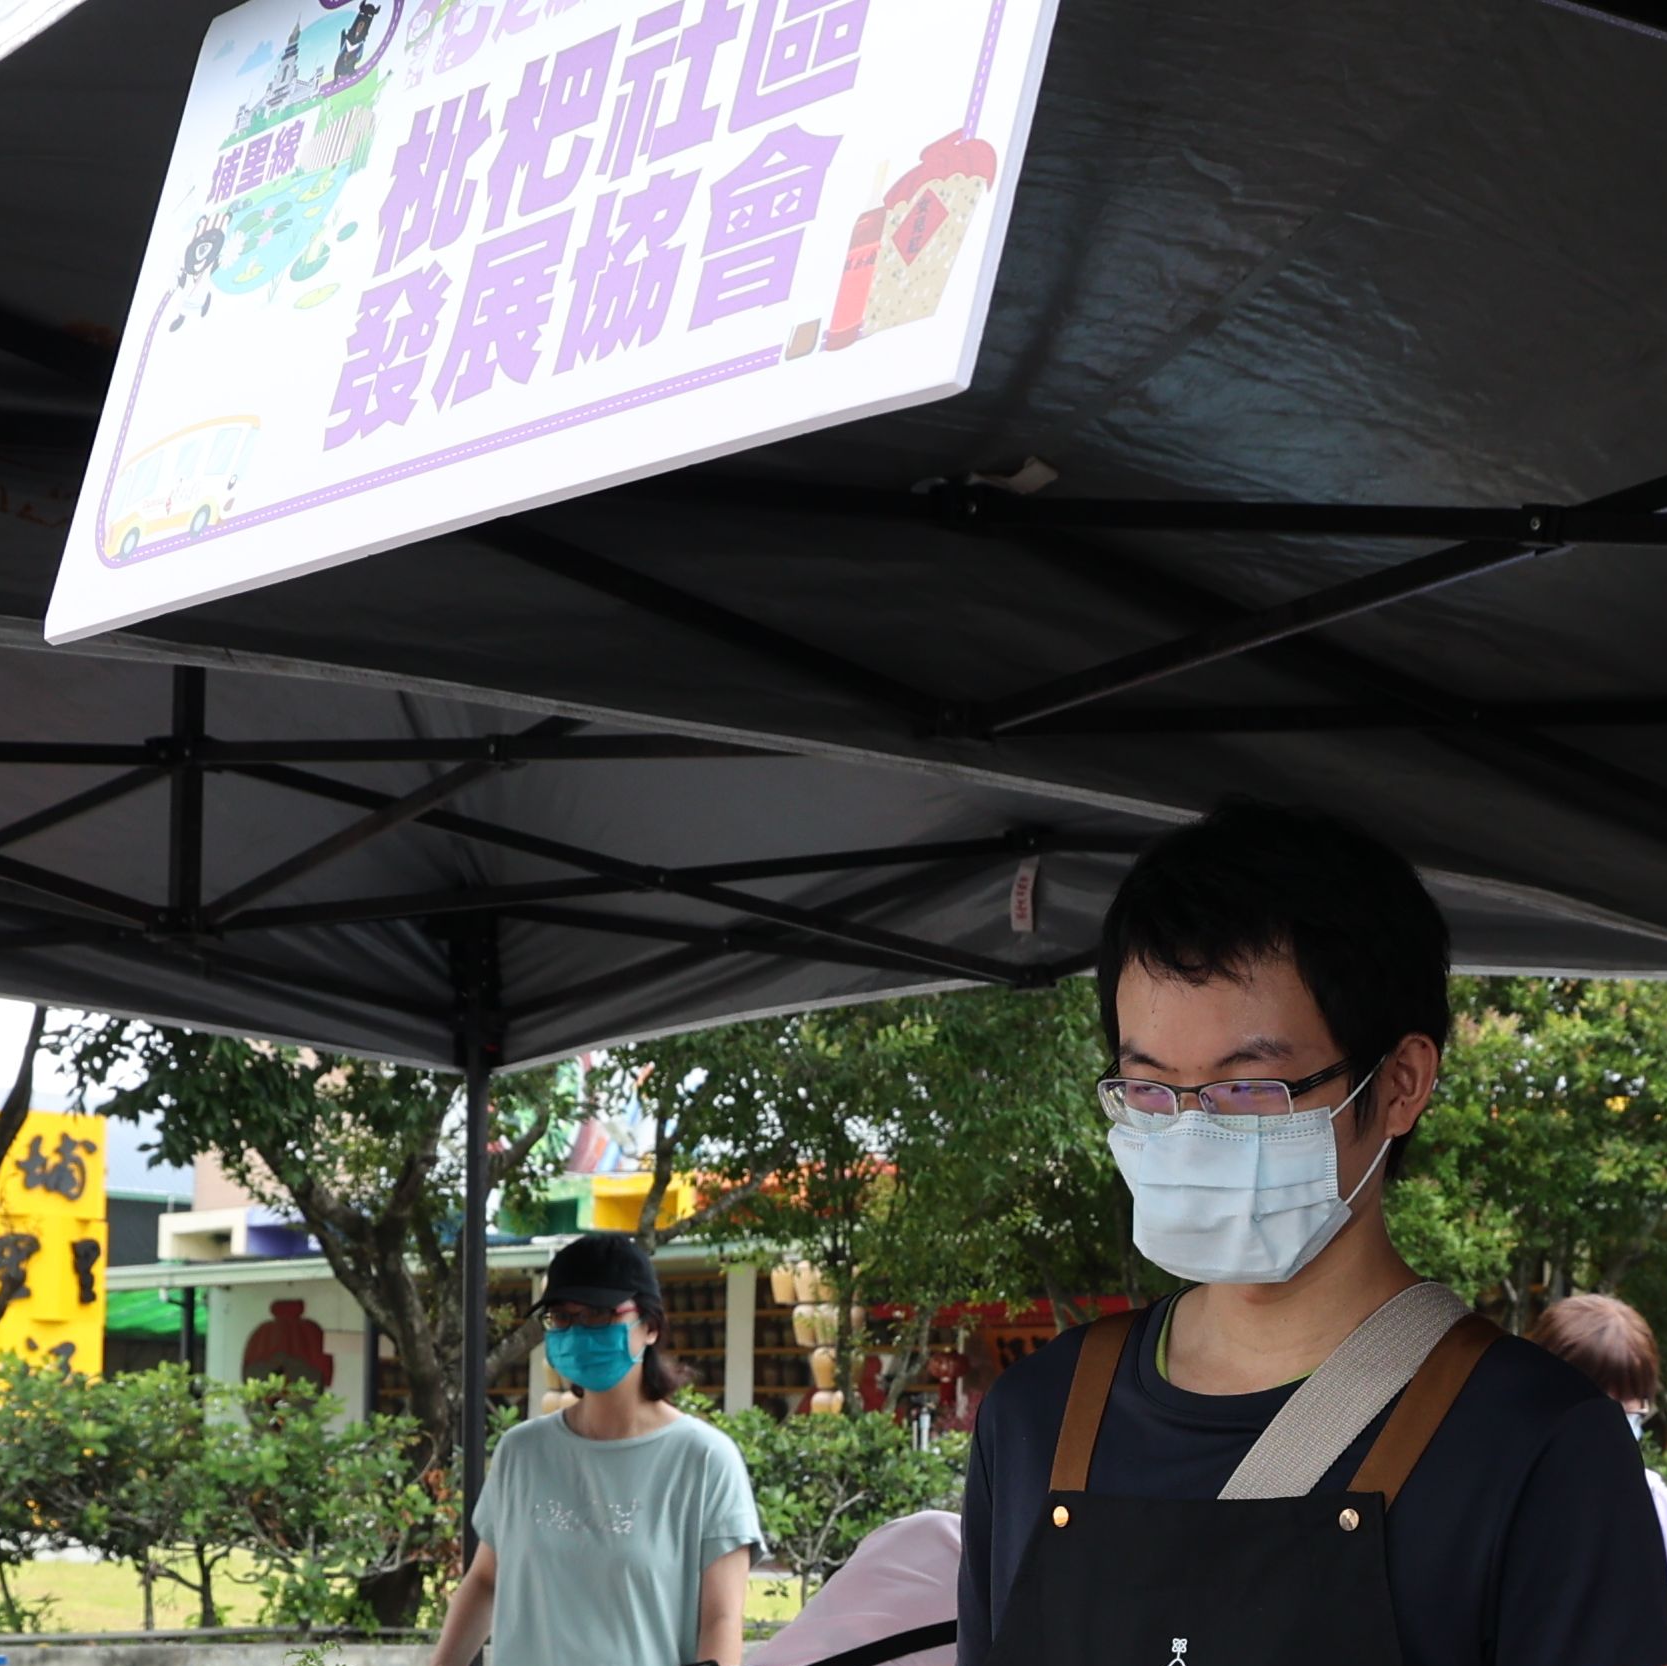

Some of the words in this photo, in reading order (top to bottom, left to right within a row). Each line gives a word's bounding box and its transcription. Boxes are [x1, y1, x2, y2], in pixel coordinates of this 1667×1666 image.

[206, 119, 305, 204] 埔里線
[325, 127, 845, 451] 發展協會
